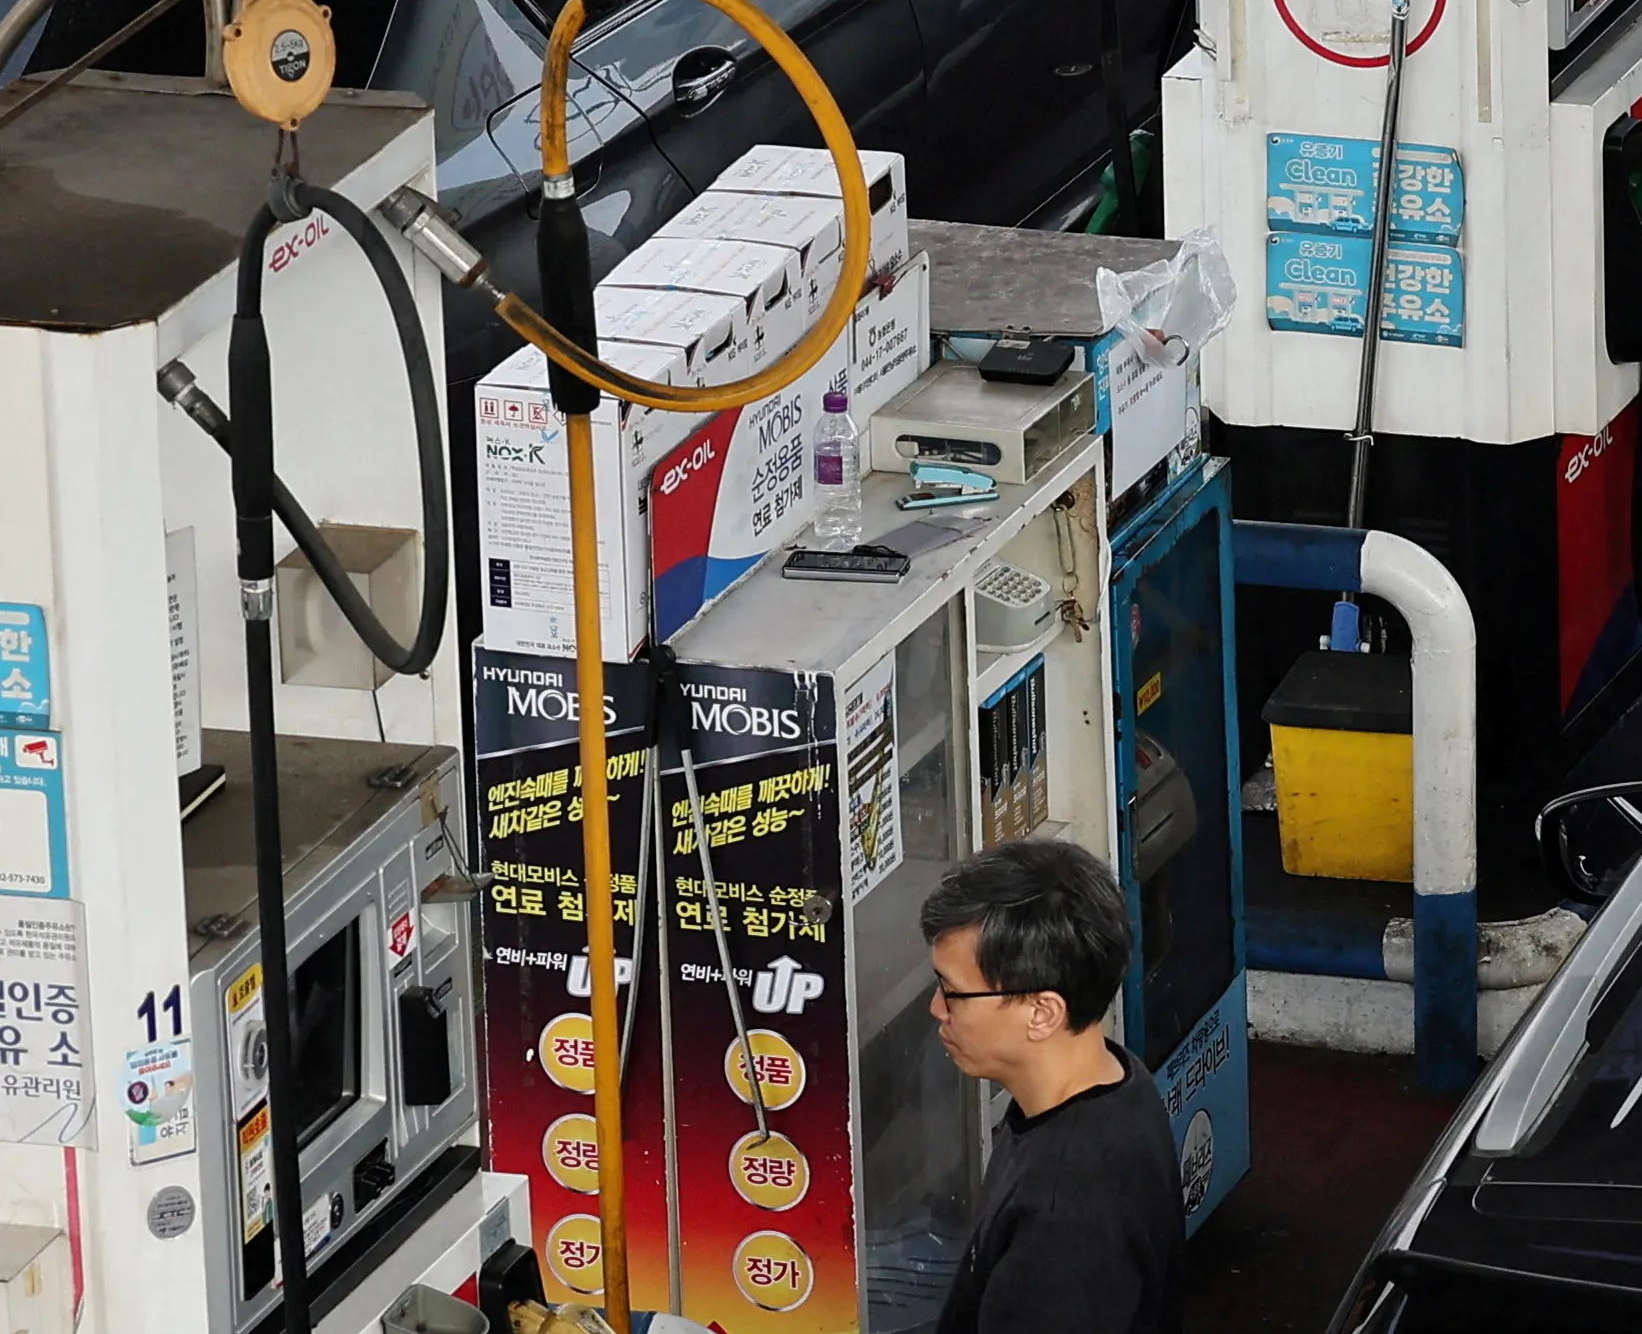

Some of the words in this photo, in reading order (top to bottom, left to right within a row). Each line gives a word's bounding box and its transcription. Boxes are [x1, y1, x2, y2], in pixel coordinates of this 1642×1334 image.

[1285, 158, 1358, 187] Clean
[268, 213, 330, 272] ex-OIL
[1284, 258, 1357, 287] Clean
[749, 392, 782, 430] HYUNDAI
[757, 393, 803, 455] MOBIS
[659, 438, 716, 496] ex-OIL
[751, 433, 804, 504] 순정용품
[752, 502, 773, 538] 연료
[773, 474, 803, 520] 첨가제
[483, 665, 563, 688] HYUNDAI
[680, 682, 747, 702] YUNDAI
[506, 685, 618, 725] MOBS
[691, 700, 801, 740] MOBIS
[487, 767, 570, 812] 엔진속때를
[573, 748, 646, 788] 하게!
[757, 763, 831, 804] 깨끗하게!
[488, 799, 562, 839] 새차같은
[566, 793, 621, 822] 성~
[751, 806, 806, 837] 성능~
[491, 859, 580, 887] 현대모비스
[491, 884, 547, 916] 연료
[557, 890, 638, 926] 첨제
[675, 900, 732, 932] 연료
[495, 946, 568, 971] 연비+파워
[752, 954, 825, 1014] UP
[137, 984, 183, 1043] 11
[739, 1054, 793, 1086] 정품
[741, 1155, 796, 1187] 정량
[745, 1256, 801, 1289] 정가
